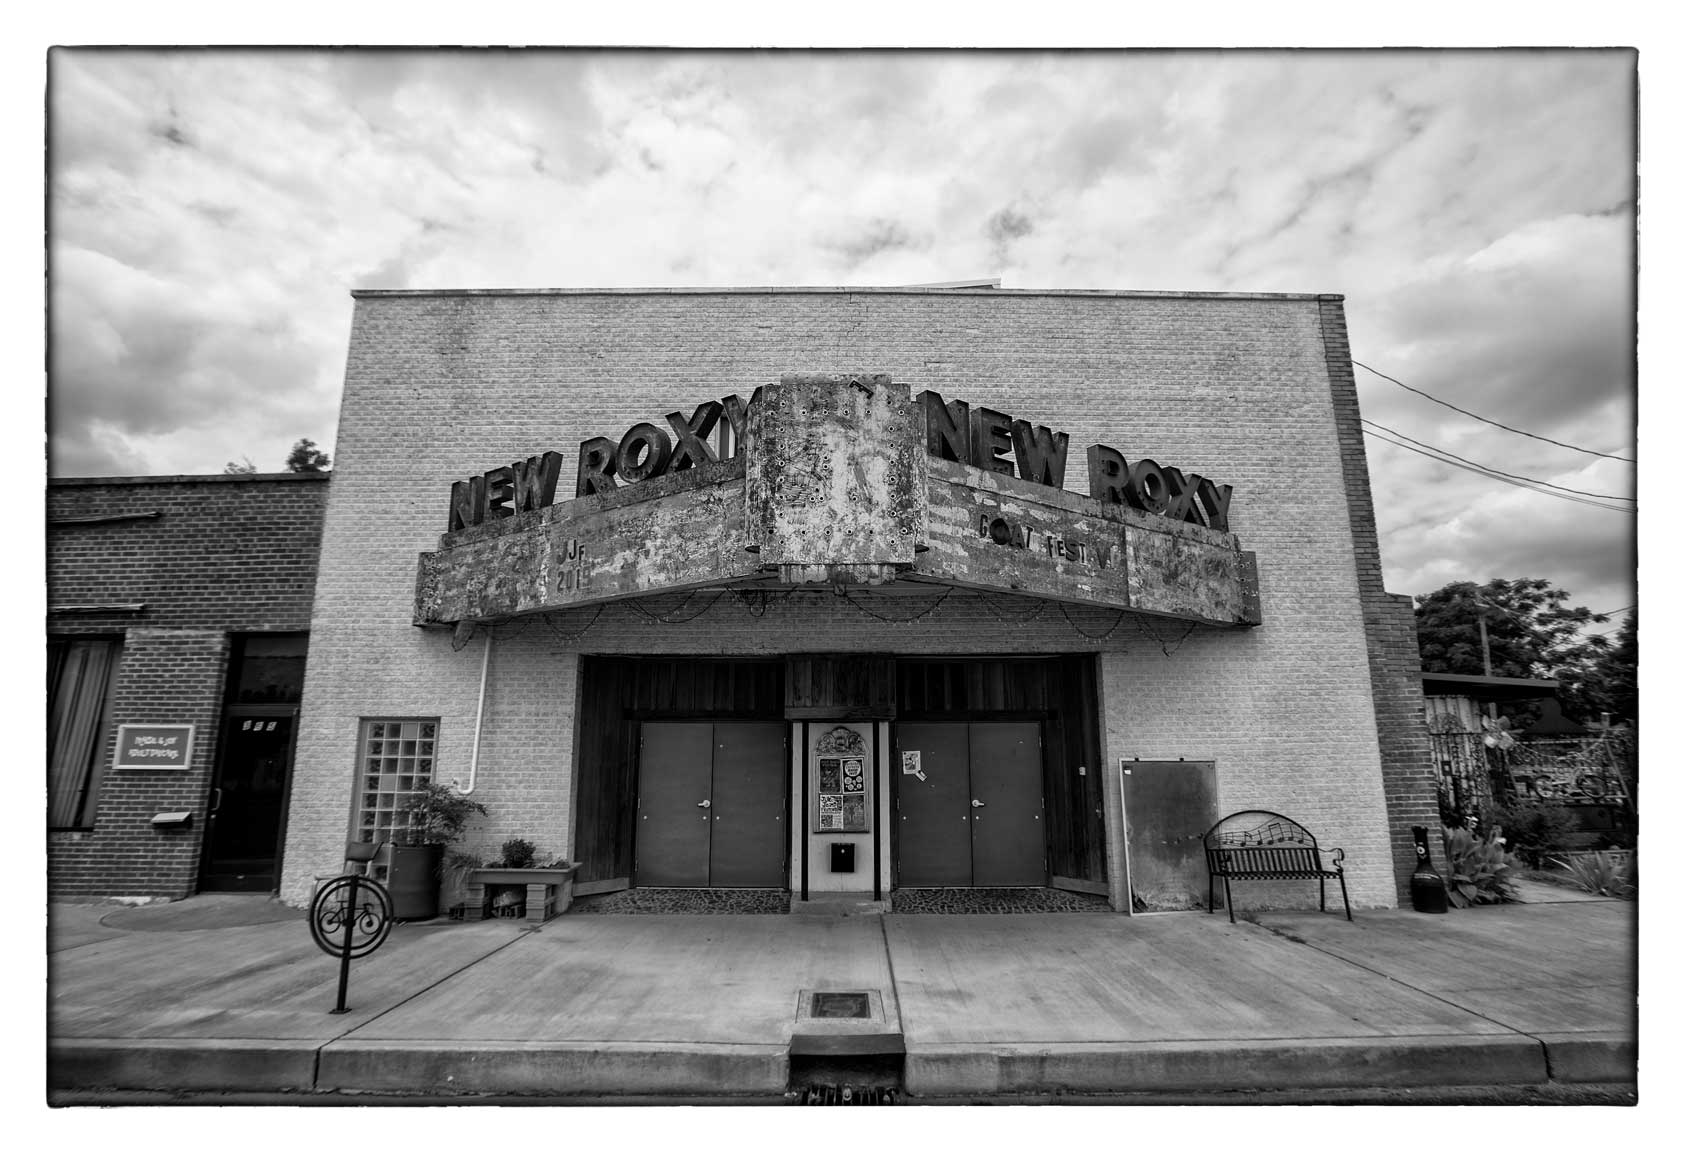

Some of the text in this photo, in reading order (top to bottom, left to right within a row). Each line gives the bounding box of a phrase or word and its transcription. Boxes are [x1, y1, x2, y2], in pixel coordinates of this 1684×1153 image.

[449, 384, 763, 533] NEW ROXY
[916, 389, 1233, 532] NEW ROXY
[979, 513, 1033, 549] GOAT
[1046, 535, 1086, 564] FEST
